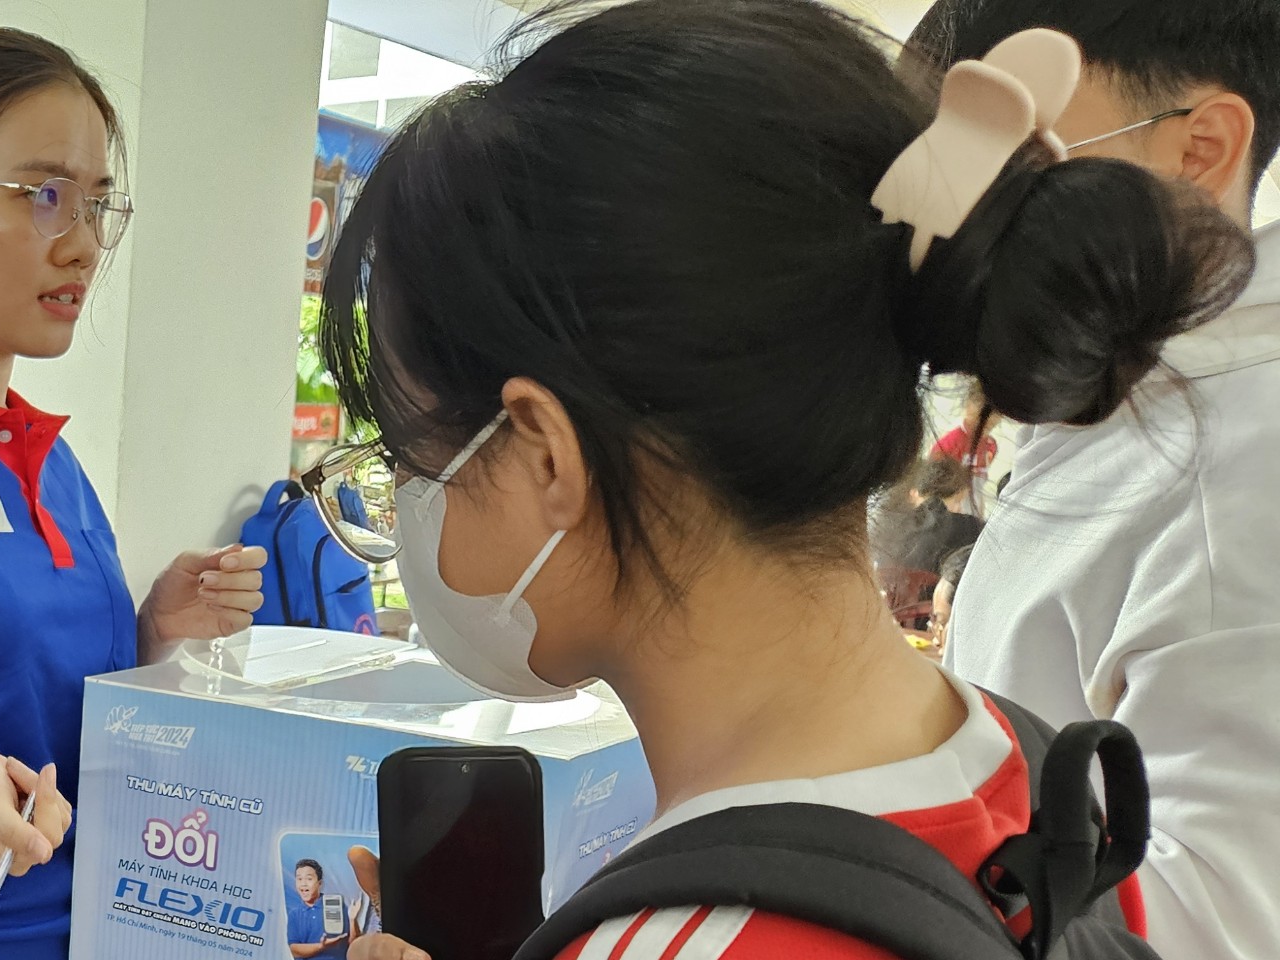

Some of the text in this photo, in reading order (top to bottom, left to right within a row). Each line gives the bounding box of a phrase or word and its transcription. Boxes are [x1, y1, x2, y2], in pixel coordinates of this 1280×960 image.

[156, 727, 192, 745] 2024
[127, 775, 264, 816] THU MÁY TÍNH CŨ
[142, 808, 219, 871] ĐỔI
[118, 858, 145, 874] MÁY
[148, 865, 178, 883] TÍNH
[181, 873, 218, 893] KHOA
[115, 877, 266, 932] FLEXIO
[127, 918, 139, 928] Chí
[139, 921, 159, 933] Minh,
[158, 927, 176, 940] ngày
[177, 931, 186, 940] 19
[186, 933, 207, 947] tháng
[207, 938, 217, 949] 05
[234, 945, 254, 958] 2024
[172, 916, 198, 930] MANG
[198, 921, 217, 935] VÀO
[217, 927, 248, 943] PHÒNG
[248, 935, 265, 948] THI
